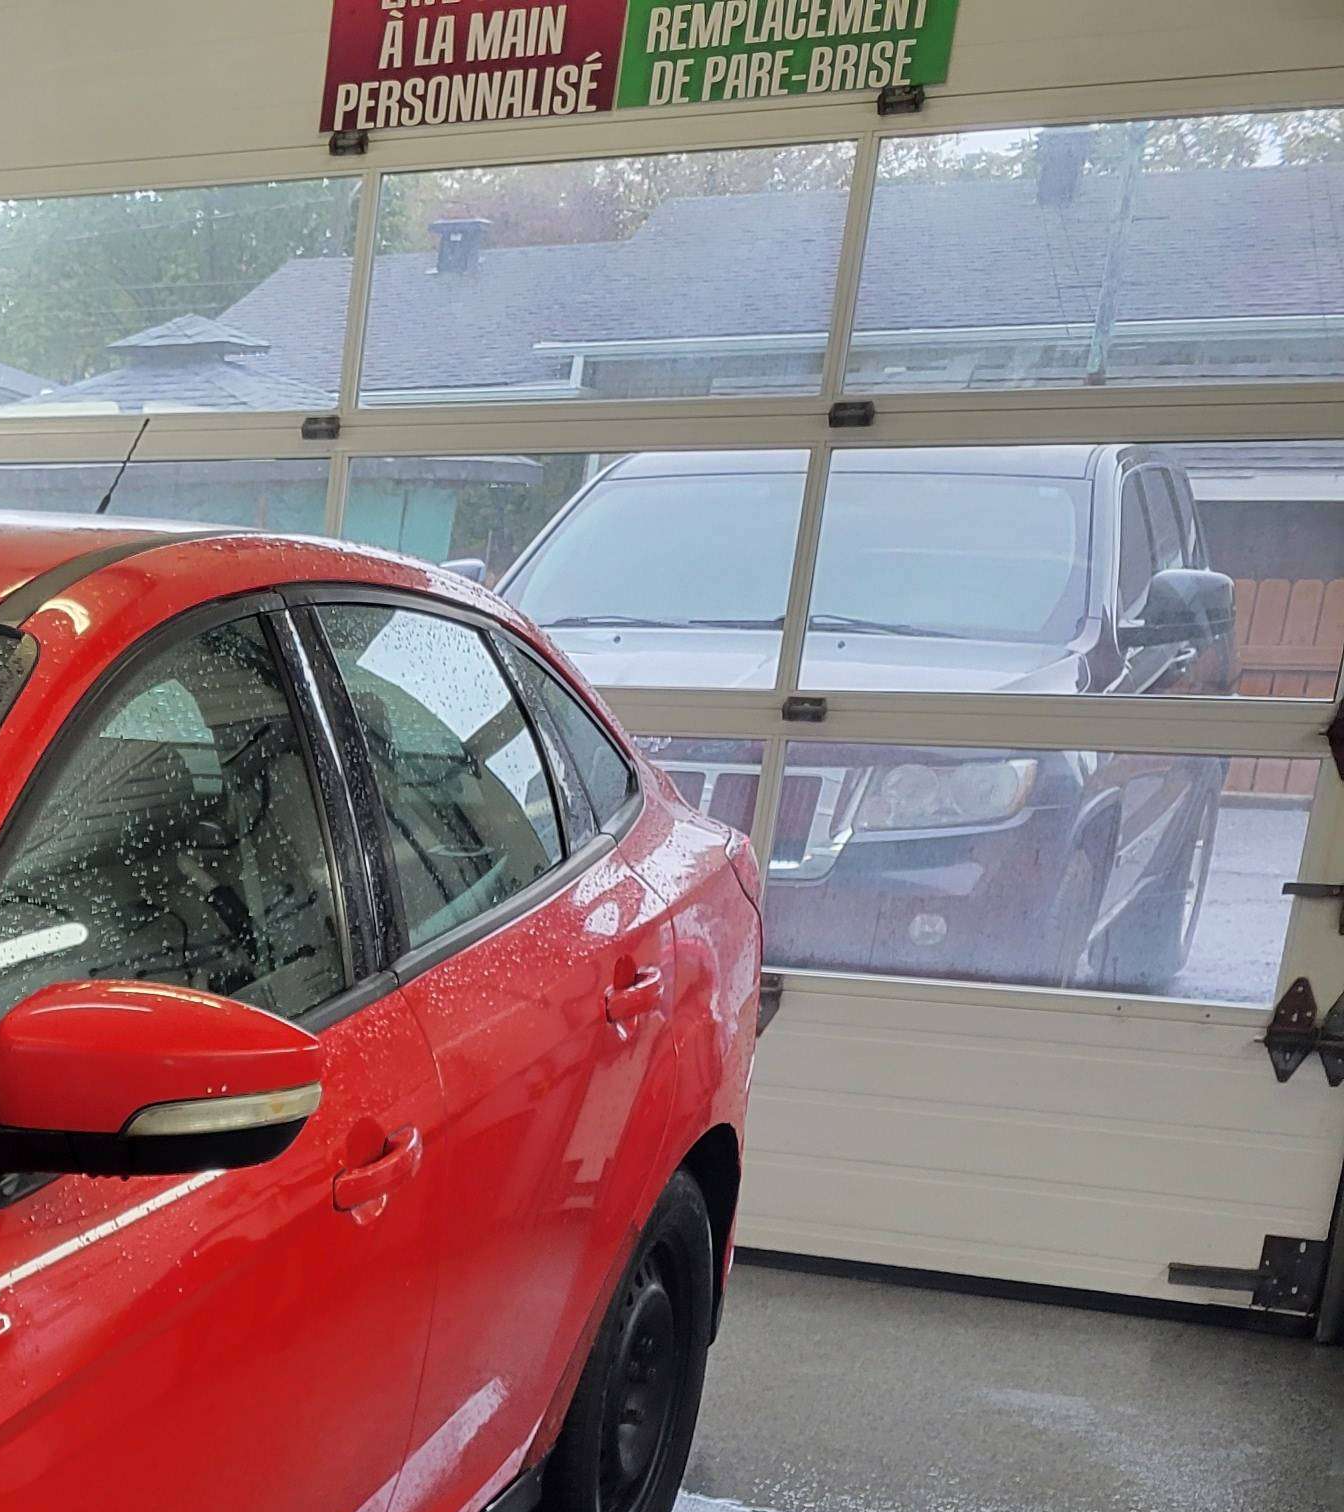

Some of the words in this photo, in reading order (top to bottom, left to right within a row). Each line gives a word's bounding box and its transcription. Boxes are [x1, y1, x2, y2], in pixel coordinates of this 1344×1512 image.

[378, 9, 404, 70] À
[414, 15, 456, 67] LA
[466, 5, 568, 62] MAIN
[646, 0, 927, 53] REMPLACEMENT
[333, 51, 603, 132] PERSONNALISÉ
[649, 58, 695, 106] DE
[701, 39, 917, 101] PARE-BRISE
